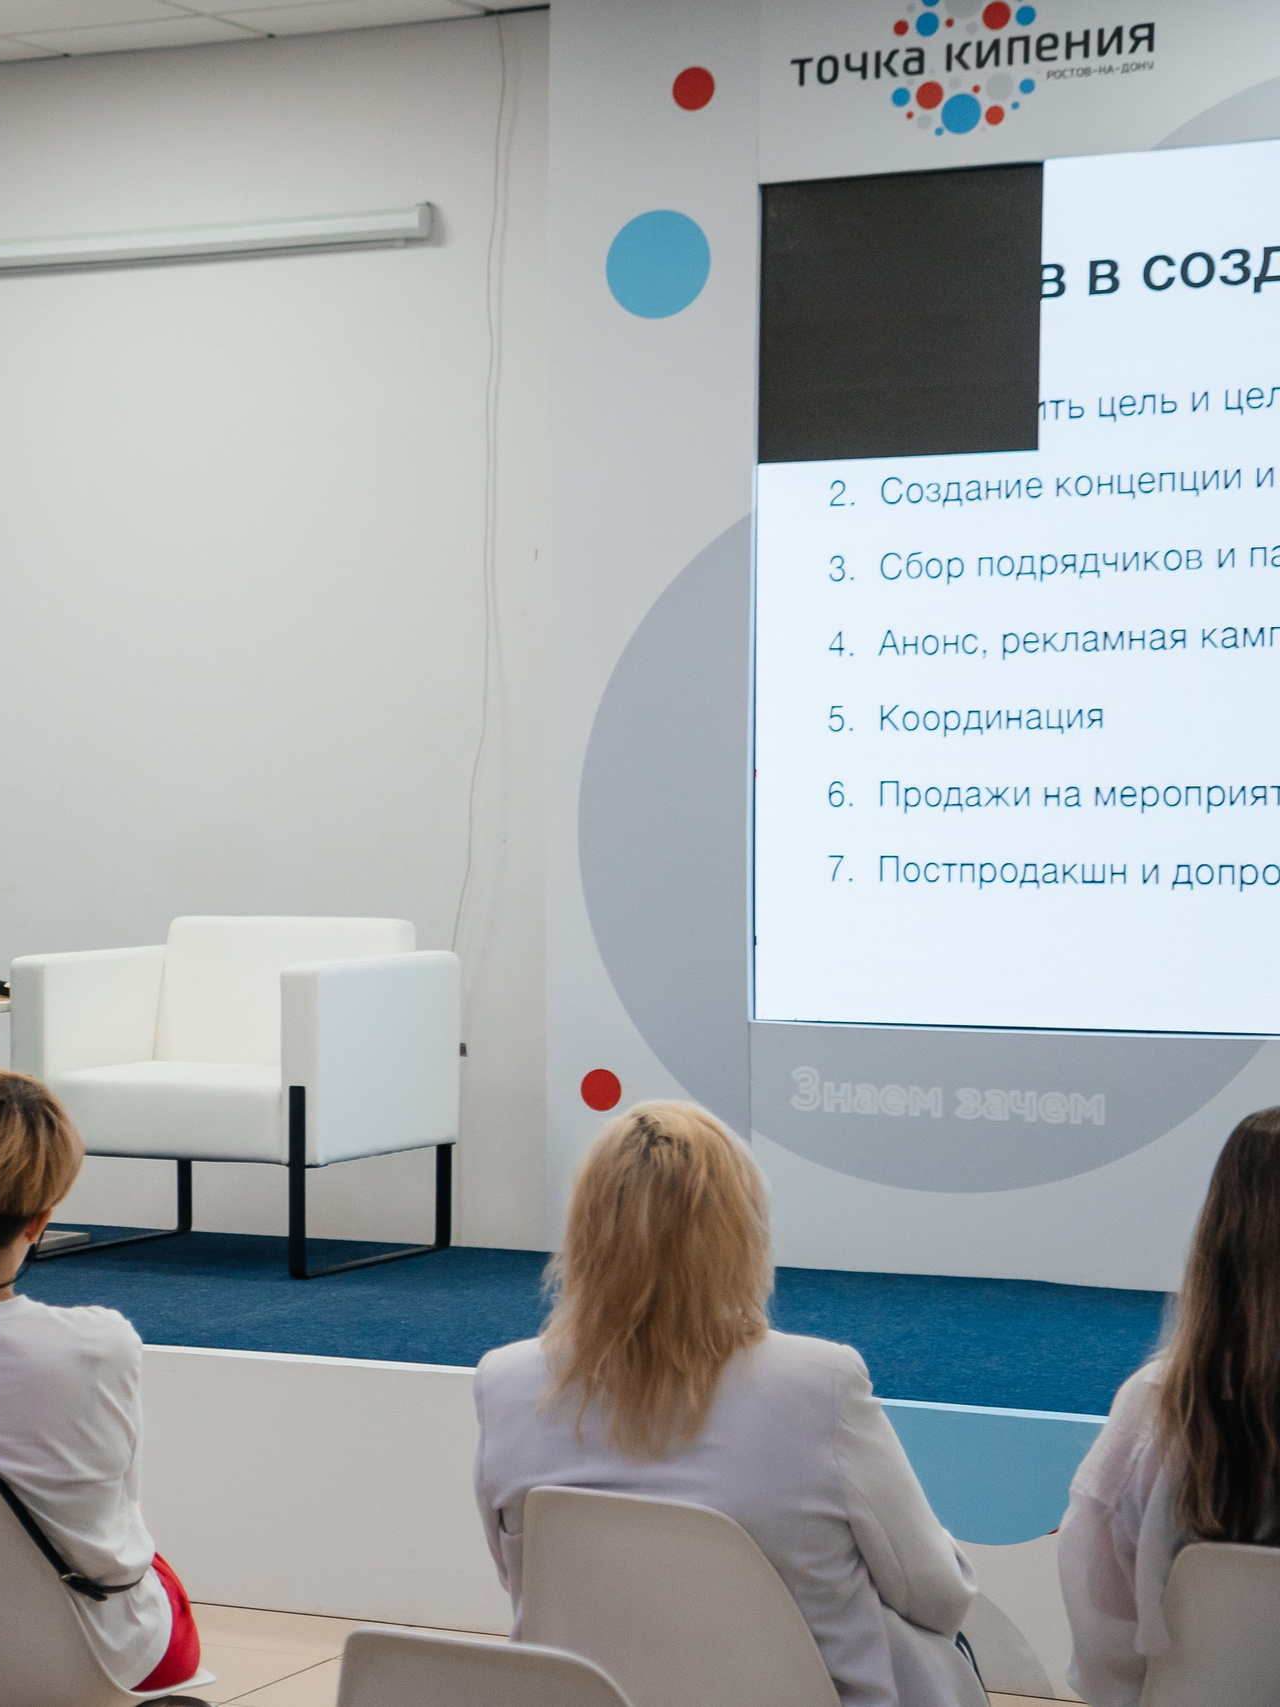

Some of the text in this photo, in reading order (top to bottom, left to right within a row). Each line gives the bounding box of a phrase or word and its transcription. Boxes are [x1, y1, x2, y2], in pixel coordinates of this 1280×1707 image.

[790, 22, 1156, 87] точка кипения
[1046, 60, 1155, 80] РОСТОВ-НА-ДОНУ
[1088, 258, 1121, 297] в
[1098, 393, 1178, 422] цель
[1191, 390, 1210, 413] и
[829, 466, 1275, 507] 2. Создание концепции и
[828, 554, 855, 583] 3.
[879, 551, 965, 585] Сбор
[977, 547, 1203, 583] подрядчиков
[1217, 547, 1236, 569] и
[828, 630, 854, 657] 4.
[878, 629, 988, 660] Анонс,
[1002, 627, 1187, 661] рекламная
[828, 704, 1105, 738] 5. Координация
[827, 780, 854, 809] 6.
[879, 780, 1031, 814] Продажи
[1044, 785, 1082, 808] на
[827, 854, 1280, 892] 7. Постпродакшн и допро
[790, 1066, 1106, 1126] Знаем зачем
